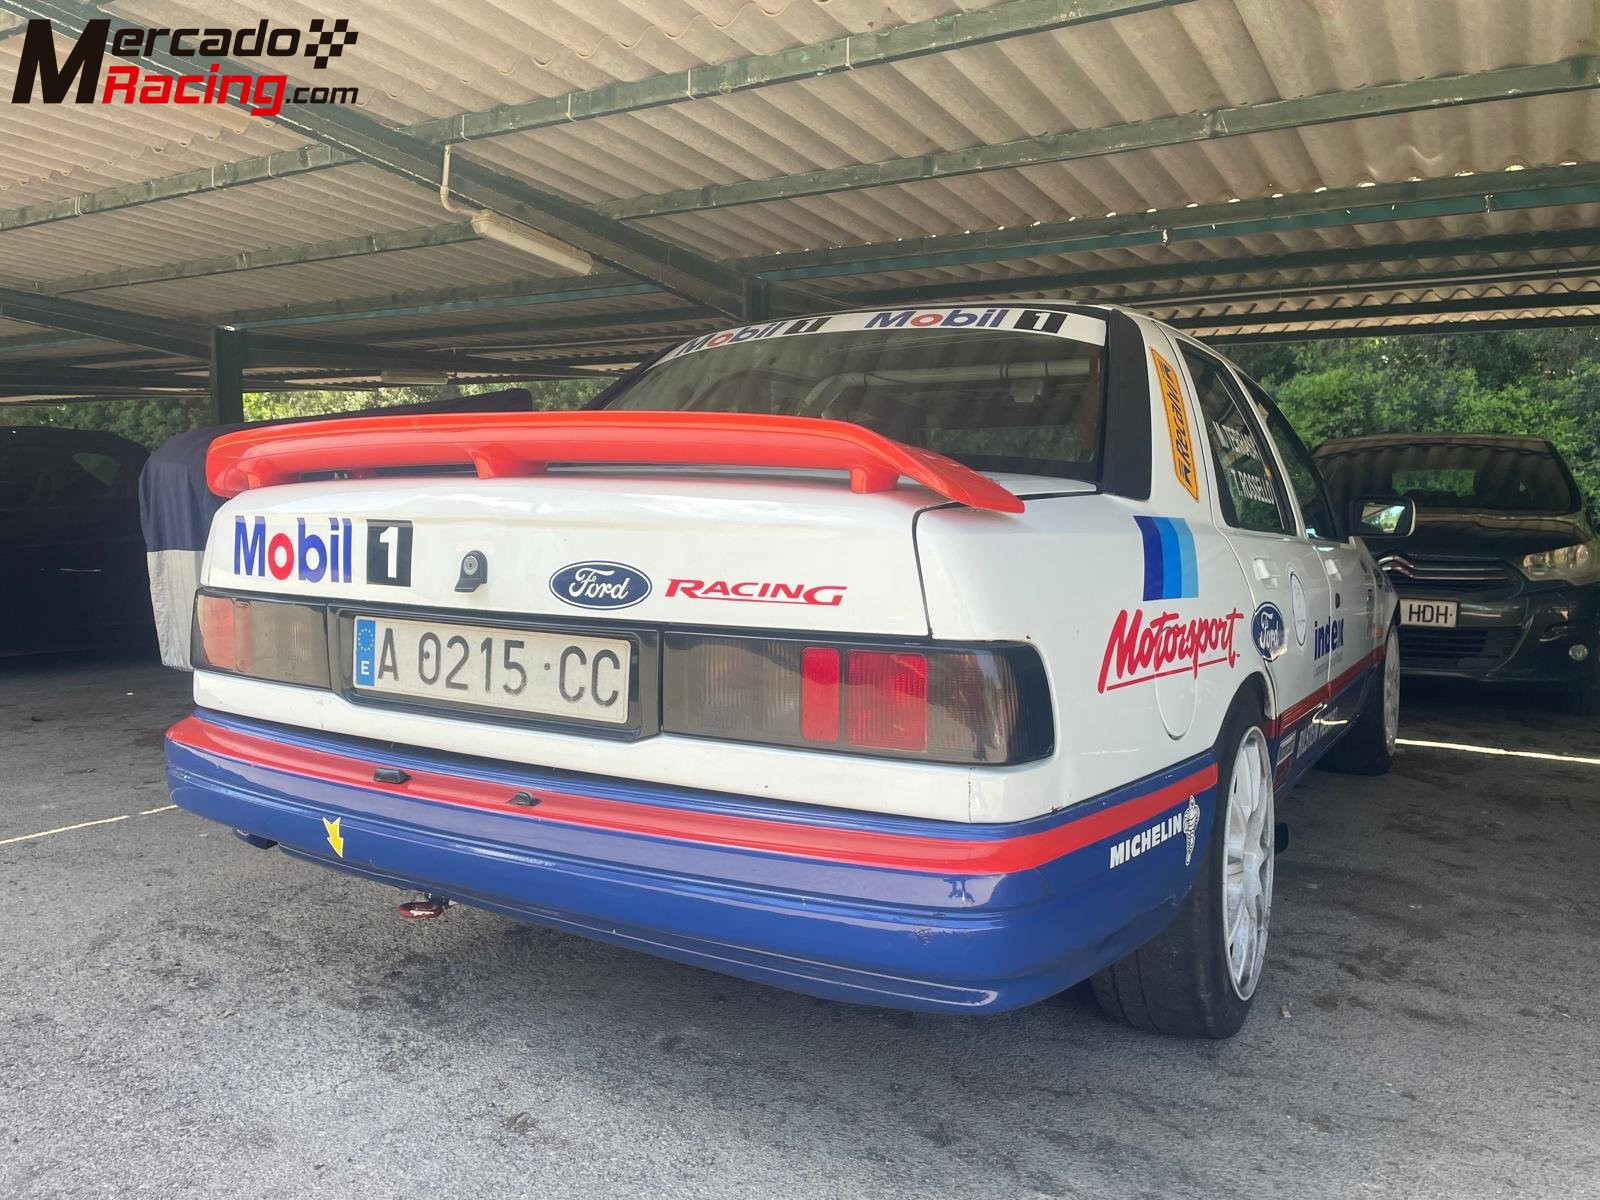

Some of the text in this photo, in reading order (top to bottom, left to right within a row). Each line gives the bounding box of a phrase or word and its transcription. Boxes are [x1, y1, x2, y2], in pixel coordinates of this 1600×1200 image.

[864, 309, 1010, 329] Mobil
[674, 321, 788, 357] Mobil
[233, 514, 353, 584] Mobil
[568, 566, 630, 600] Ford
[664, 578, 848, 606] RACING
[1259, 611, 1280, 650] Ford
[1408, 603, 1449, 624] HDH
[1097, 607, 1244, 694] Motorsport
[1313, 616, 1345, 661] index
[360, 660, 371, 676] E
[377, 627, 622, 708] A 0215 CC
[1109, 812, 1183, 869] MICHELIN
